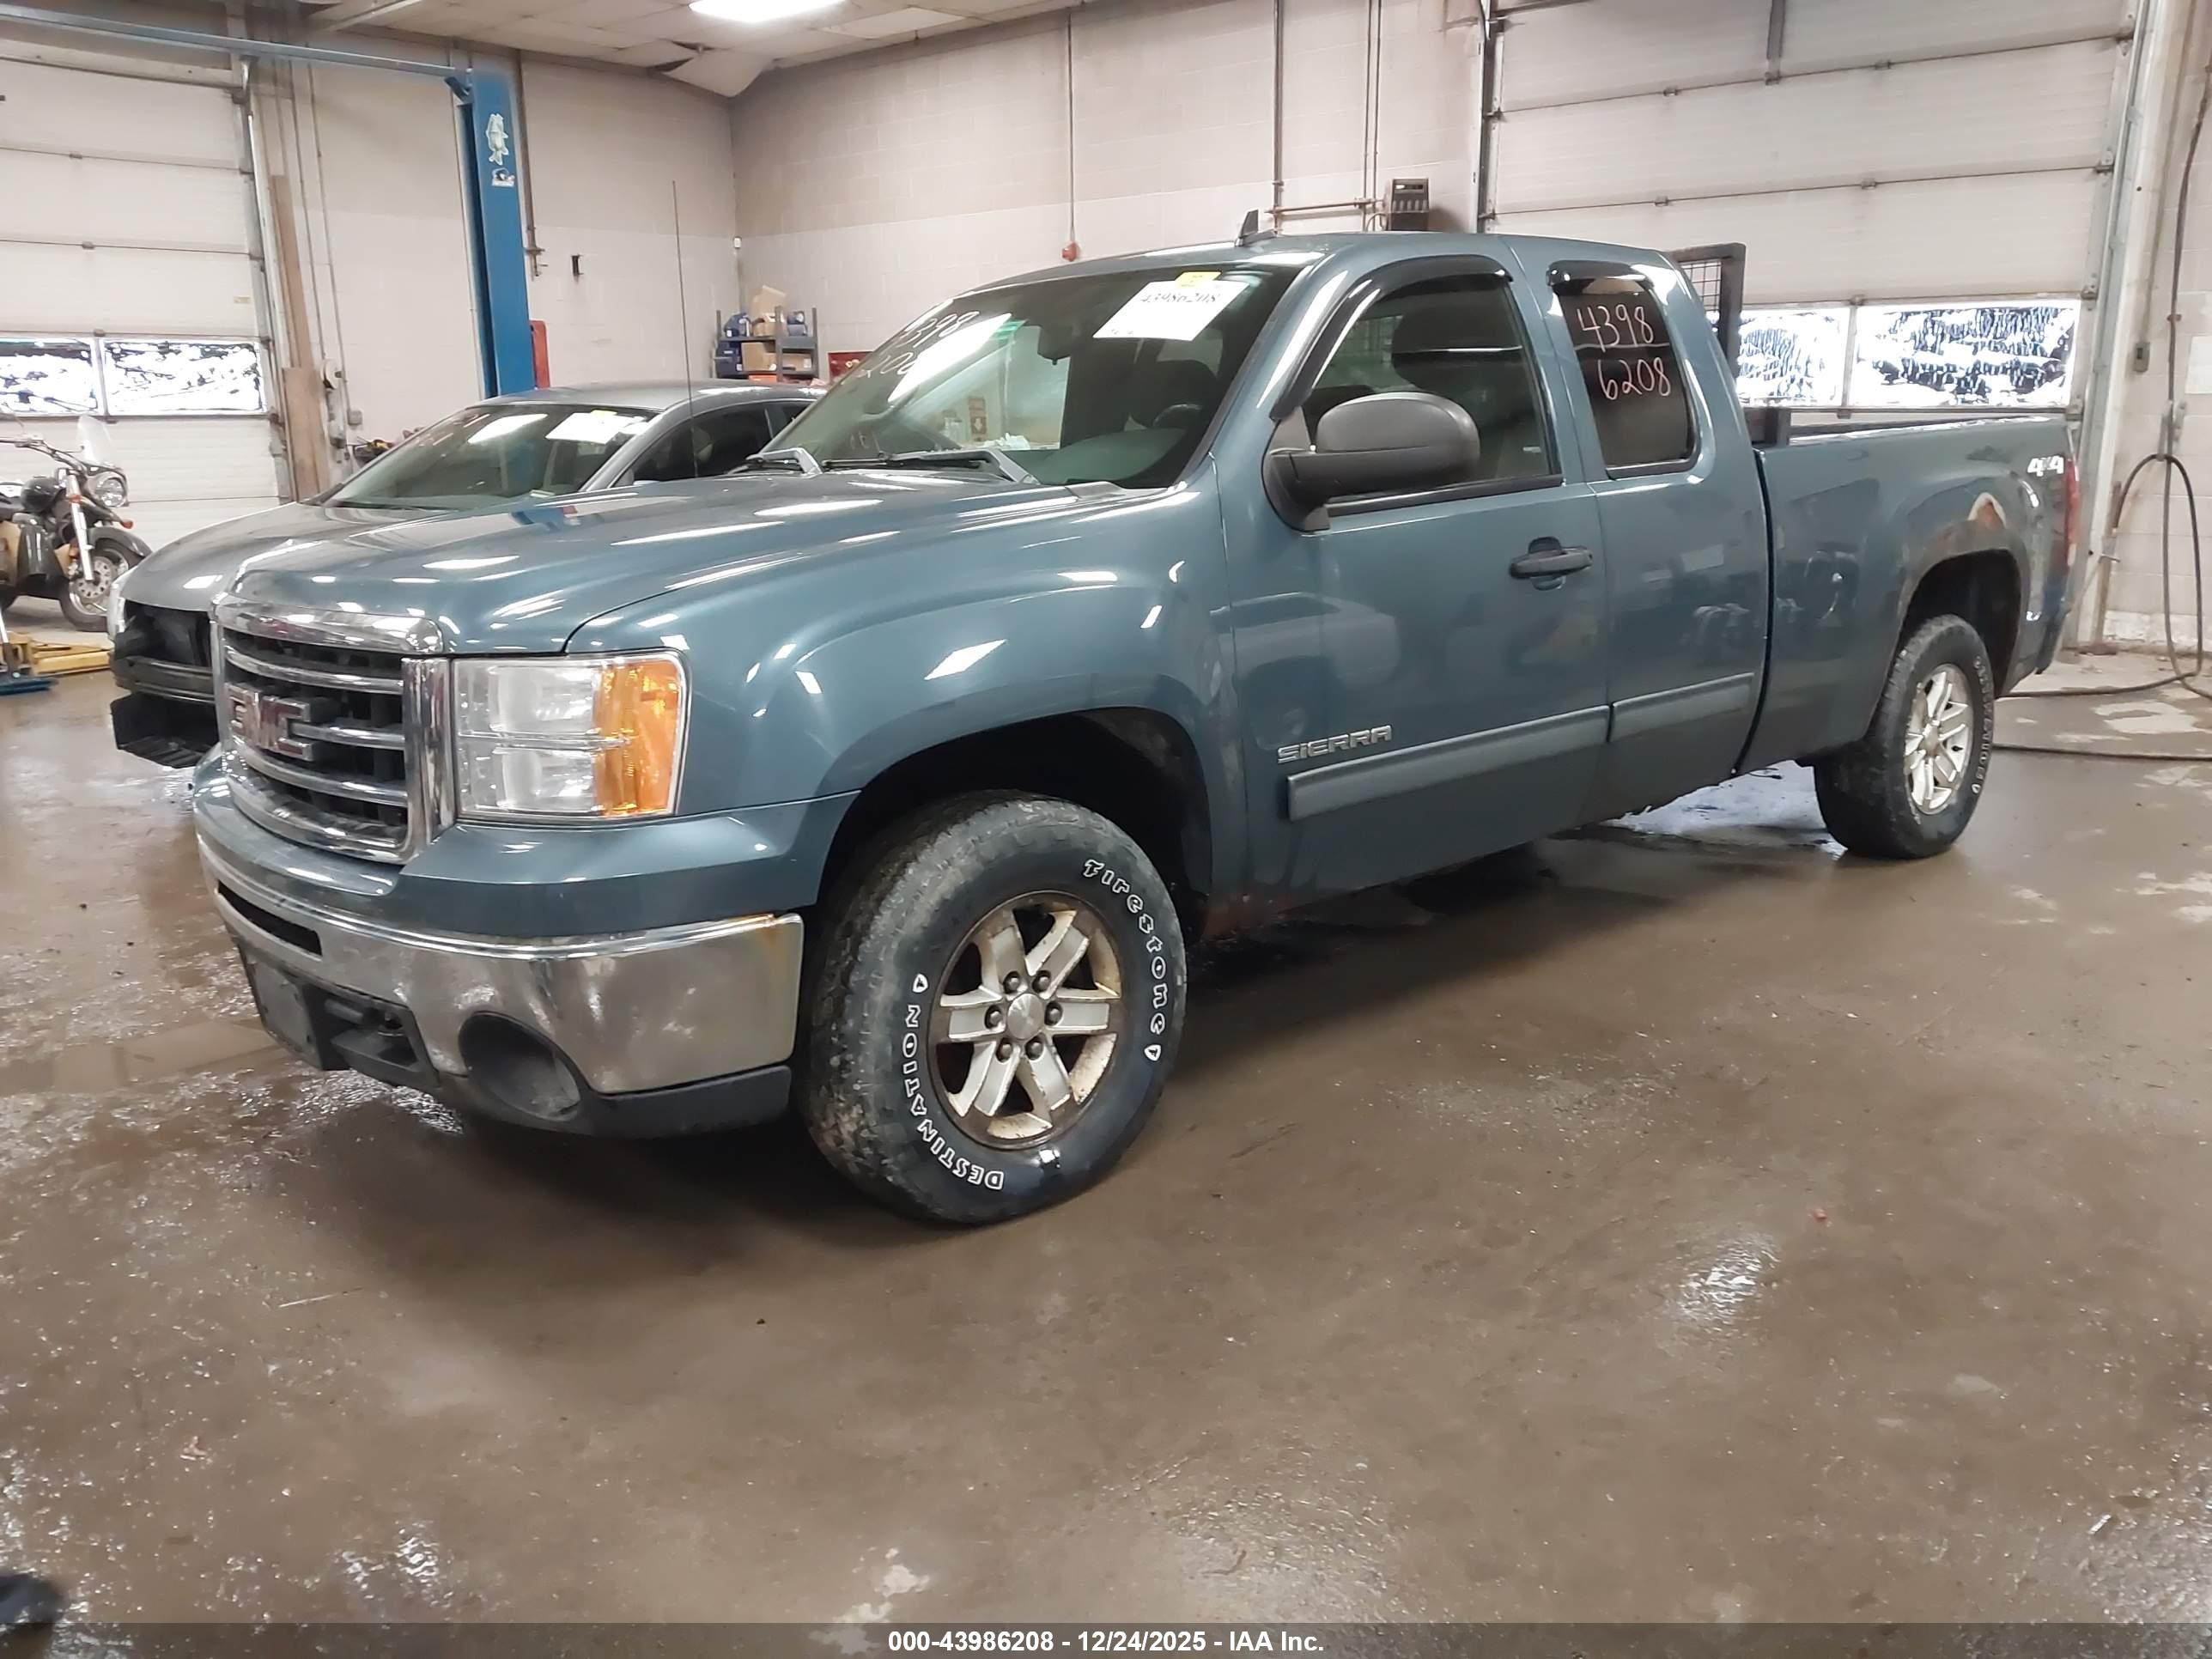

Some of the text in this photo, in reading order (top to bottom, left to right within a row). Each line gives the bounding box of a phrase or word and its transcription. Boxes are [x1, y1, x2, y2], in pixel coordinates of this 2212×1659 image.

[1577, 304, 1654, 353] 4398
[1597, 356, 1671, 400] 6208
[1278, 725, 1393, 764] SIERRA
[1082, 858, 1169, 1036] Firestone
[902, 1004, 1005, 1192] DESTINATION
